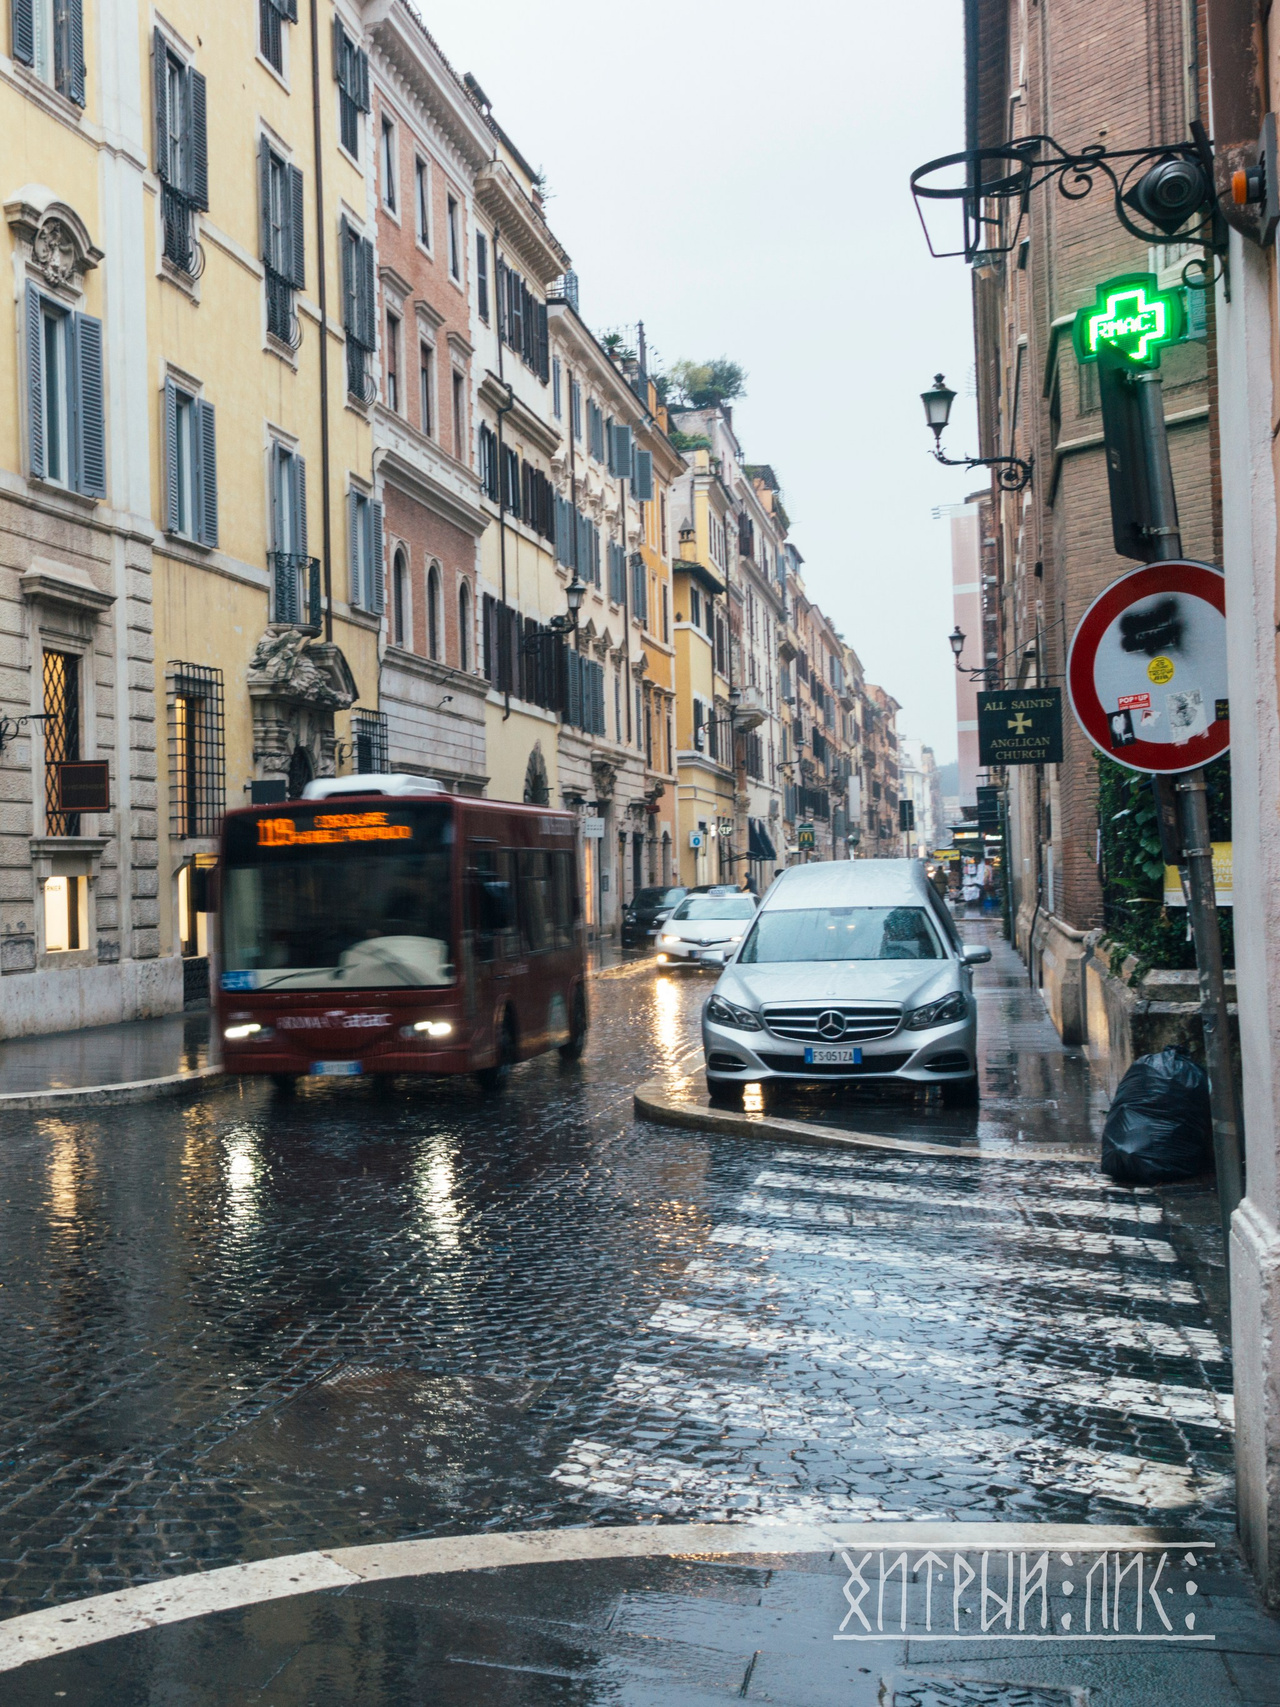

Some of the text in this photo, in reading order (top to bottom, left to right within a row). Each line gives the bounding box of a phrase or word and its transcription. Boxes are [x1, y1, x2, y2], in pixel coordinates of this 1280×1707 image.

[984, 698, 1056, 711] ALL SAINTS'
[990, 737, 1051, 748] ANGLICAN
[995, 749, 1046, 760] CHURCH
